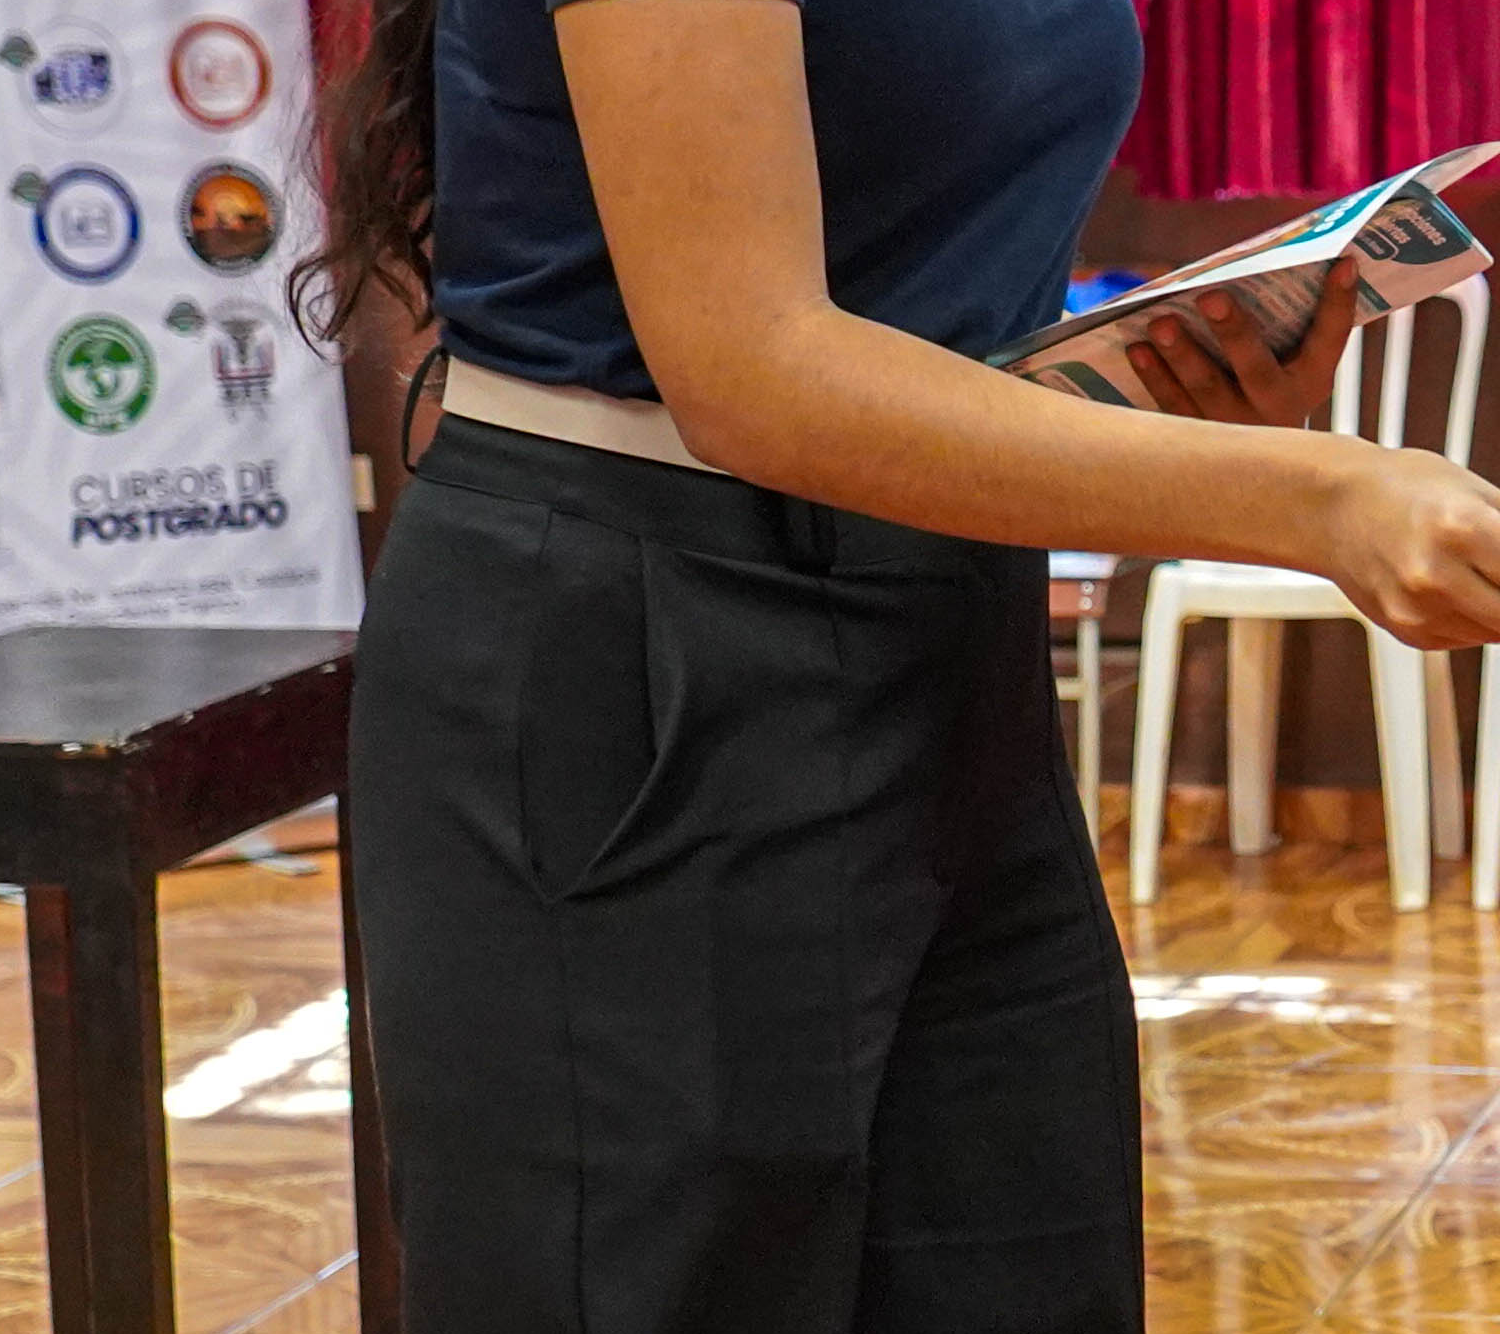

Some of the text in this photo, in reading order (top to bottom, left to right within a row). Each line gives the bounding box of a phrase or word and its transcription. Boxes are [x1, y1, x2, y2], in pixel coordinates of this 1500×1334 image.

[71, 459, 277, 510] CURSOS DE
[72, 500, 289, 547] POSTGRADO
